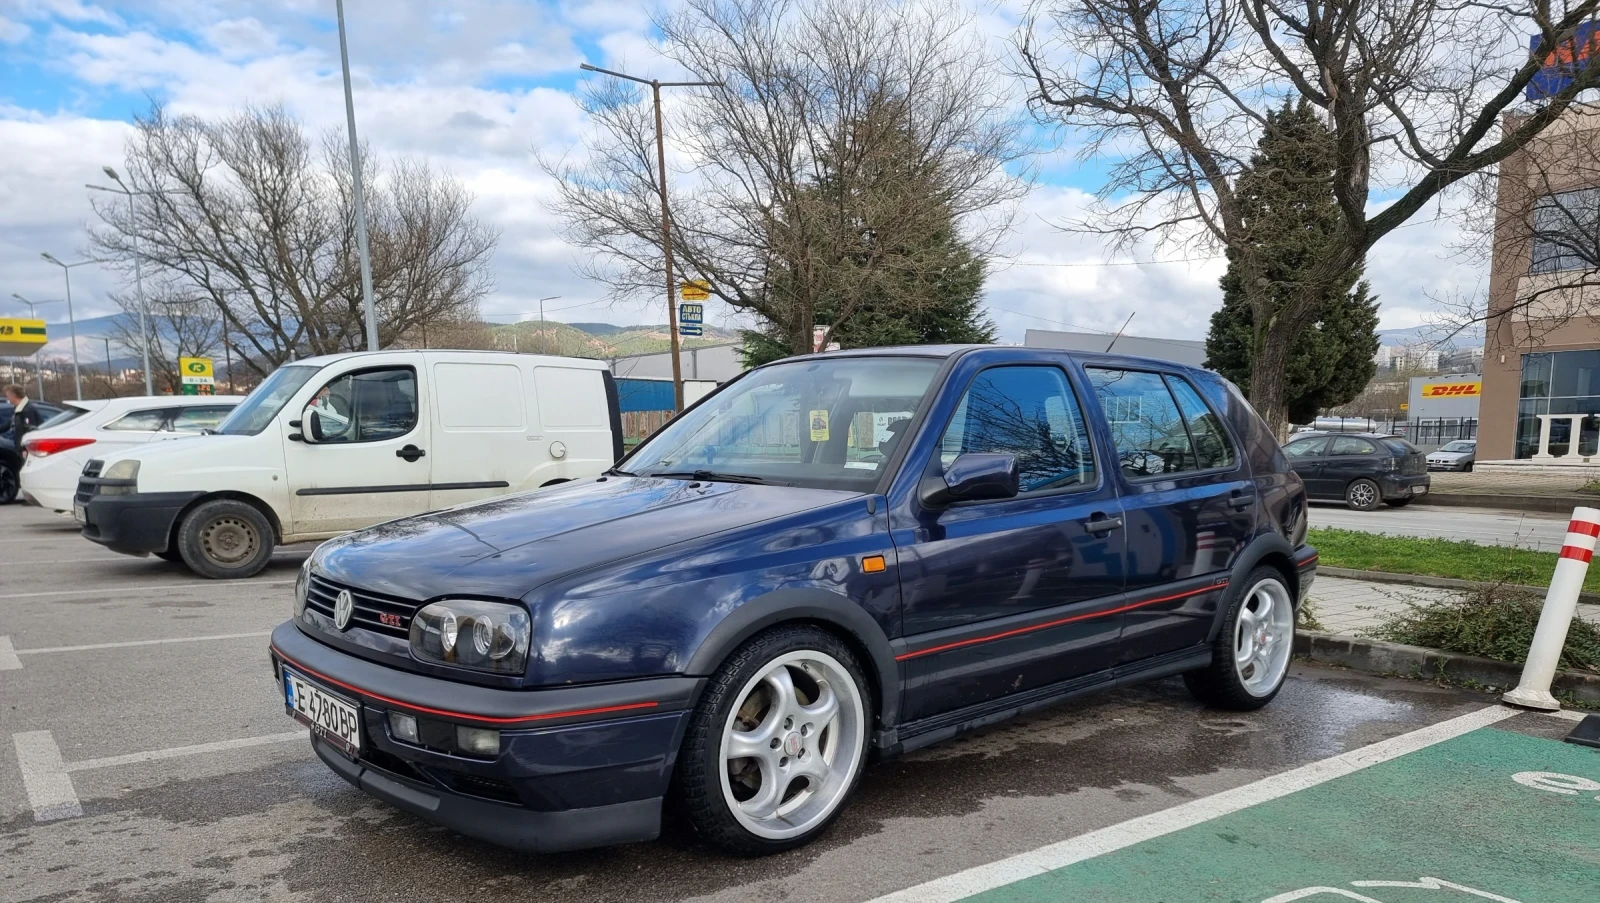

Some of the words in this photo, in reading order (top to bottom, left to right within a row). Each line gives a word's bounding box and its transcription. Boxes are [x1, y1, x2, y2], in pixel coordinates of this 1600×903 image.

[682, 305, 702, 314] АВТО
[681, 312, 702, 321] СТЪКЛА
[1431, 384, 1477, 396] DHL
[379, 611, 401, 627] GTI
